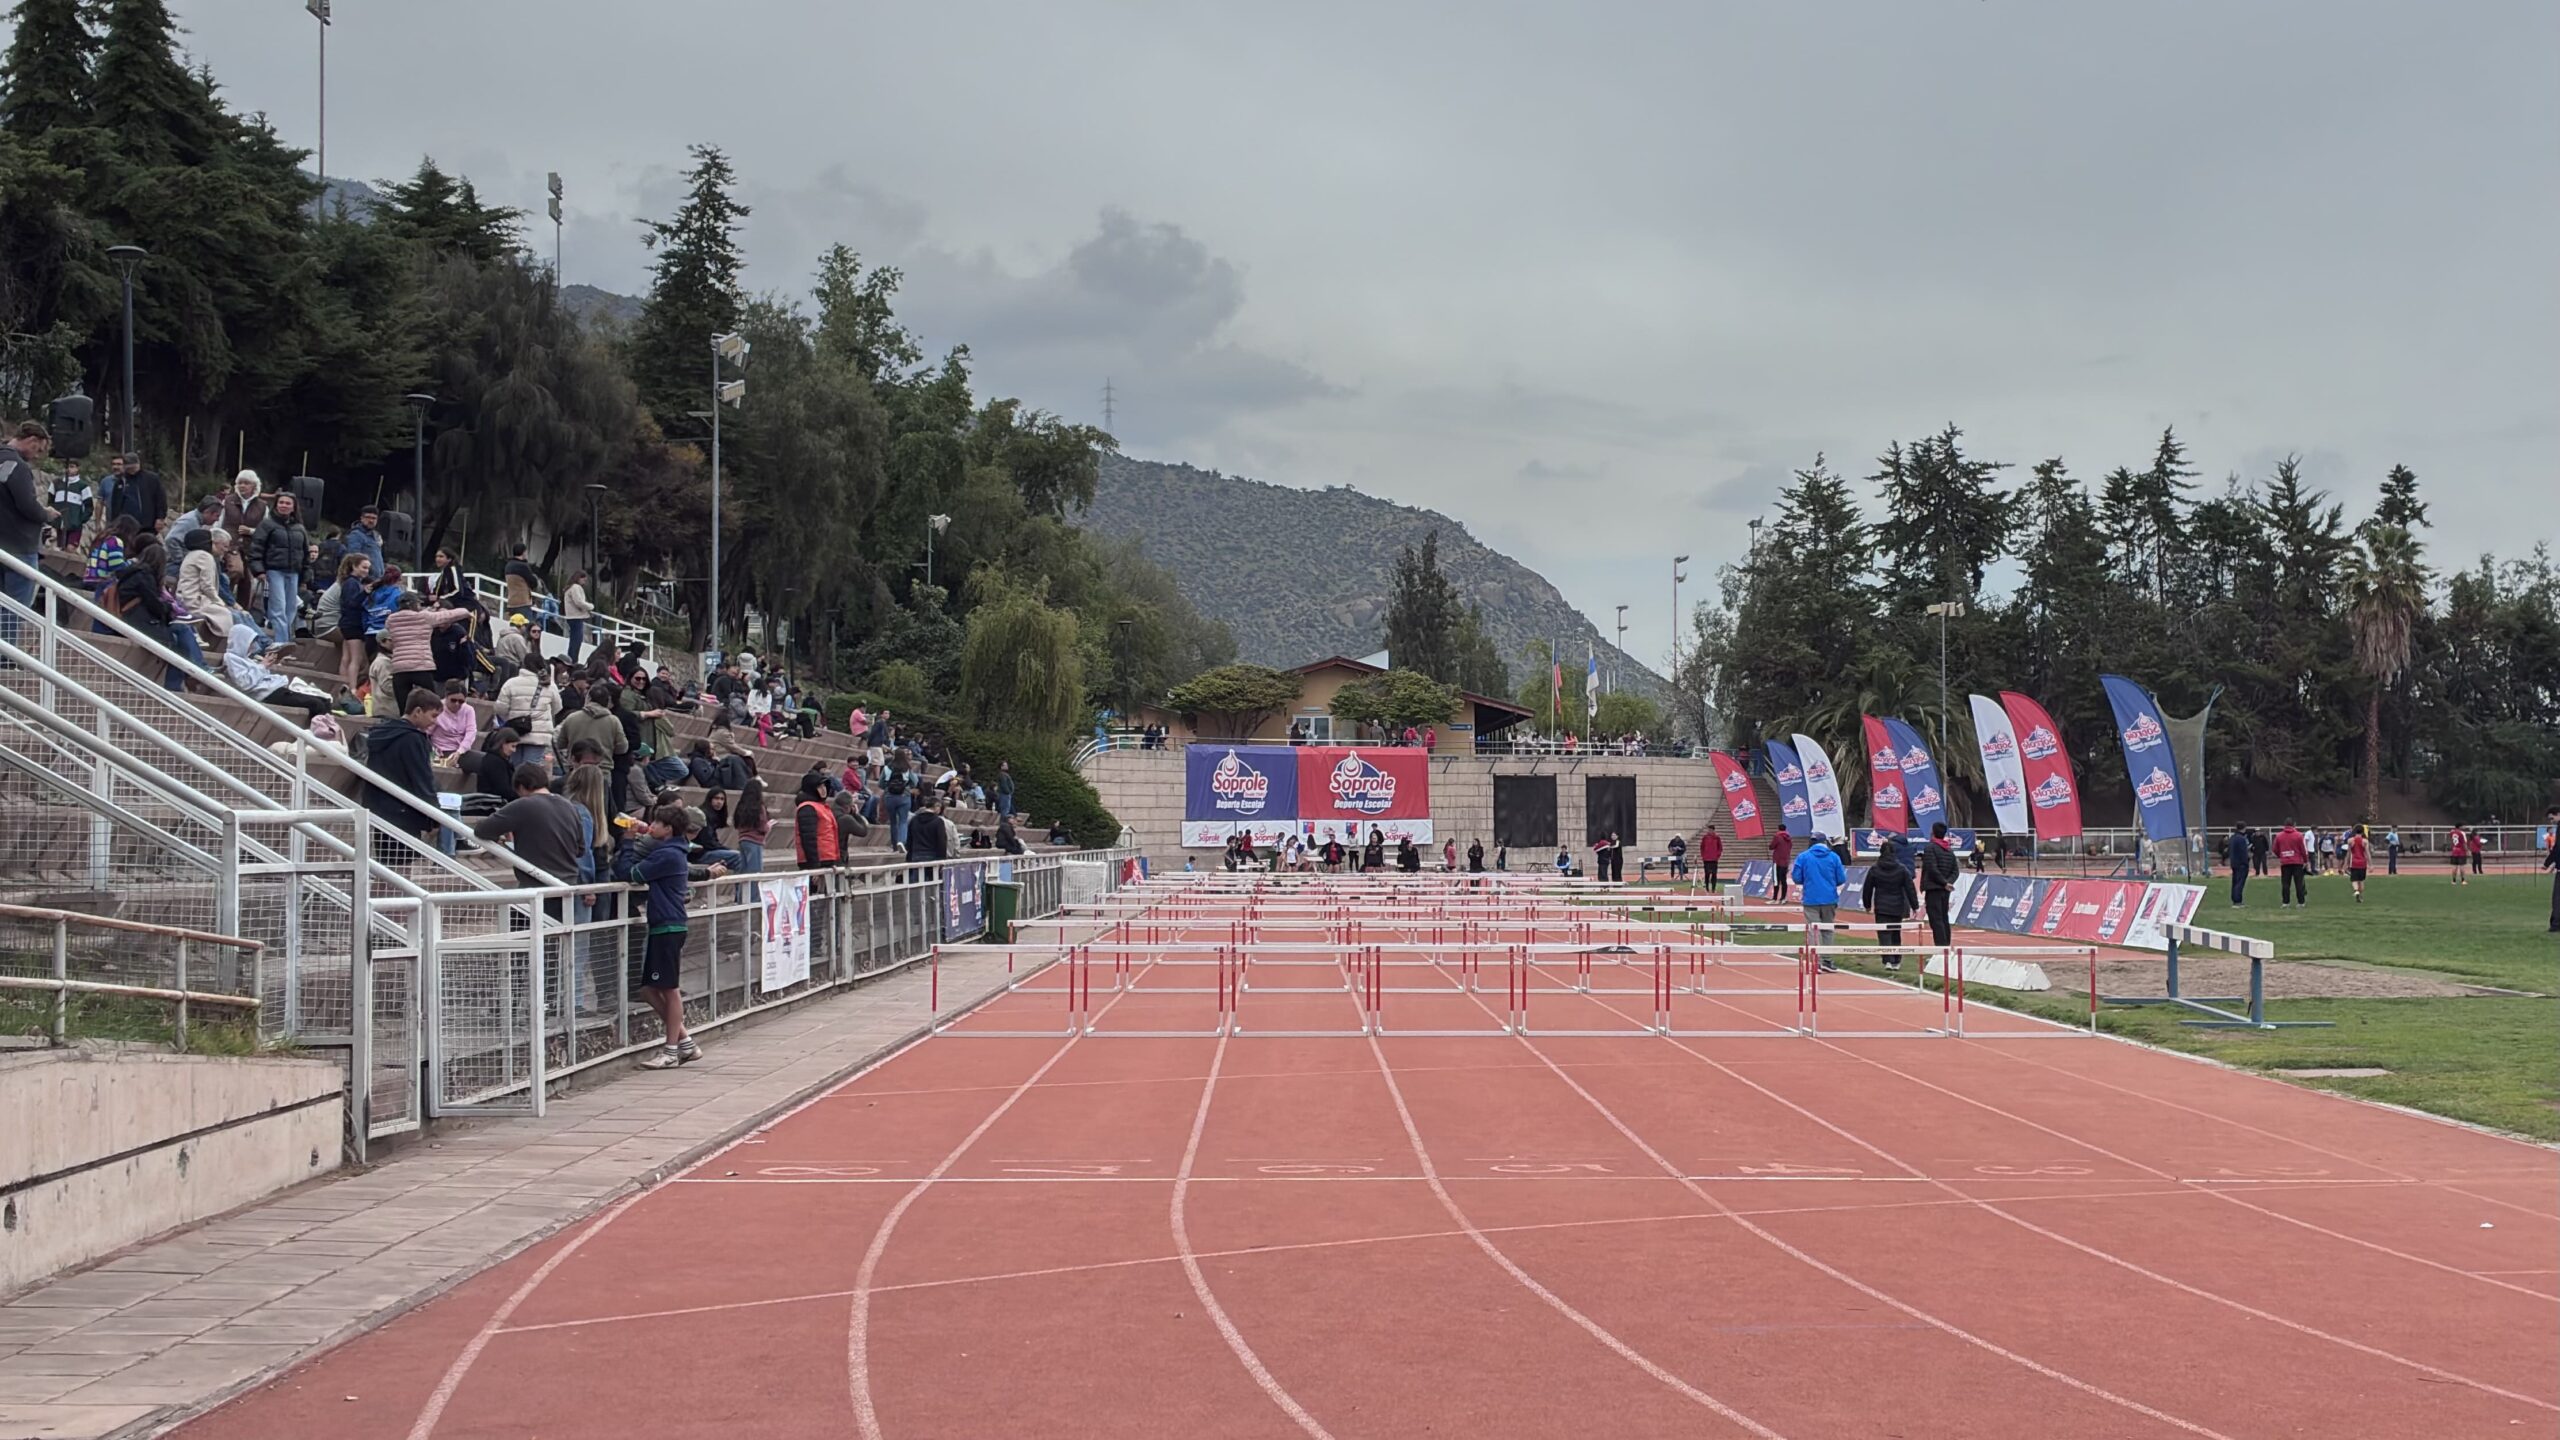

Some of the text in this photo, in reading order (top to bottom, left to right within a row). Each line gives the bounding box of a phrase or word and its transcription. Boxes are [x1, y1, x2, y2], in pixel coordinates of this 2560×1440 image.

[1213, 771, 1267, 796] Soprole
[1330, 772, 1395, 797] Soprole
[1364, 799, 1392, 809] Escolar
